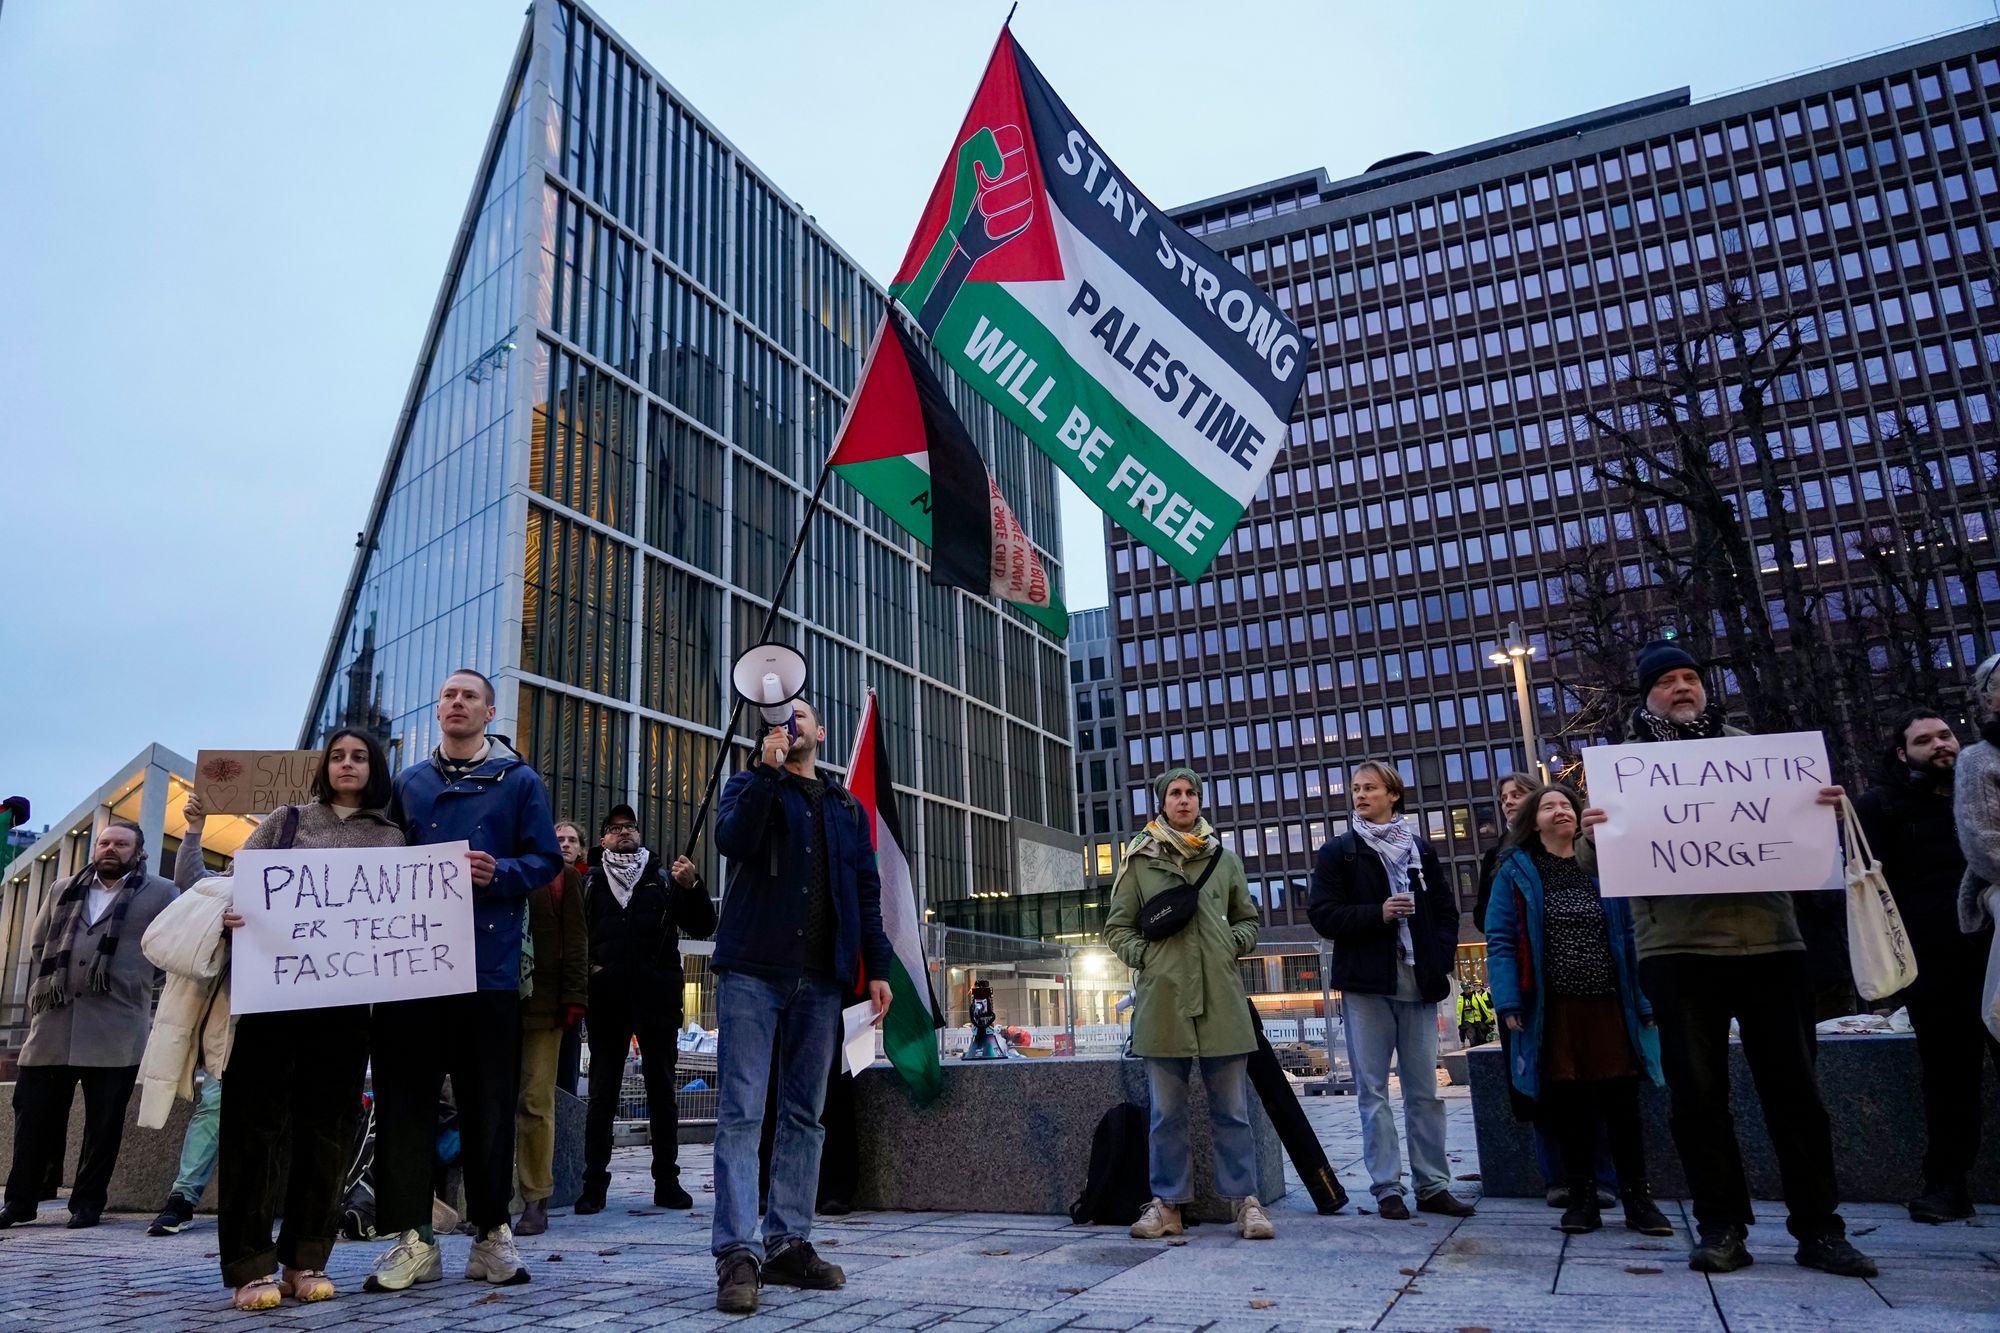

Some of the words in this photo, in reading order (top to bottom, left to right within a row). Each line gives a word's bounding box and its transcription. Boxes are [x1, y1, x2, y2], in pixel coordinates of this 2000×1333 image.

[1057, 129, 1148, 237] STAY
[1156, 230, 1300, 381] STRONG
[1067, 280, 1266, 471] PALESTINE
[963, 315, 1056, 423] WILL
[1056, 405, 1114, 474] BE
[1106, 454, 1215, 555] FREE
[1615, 756, 1823, 793] PALANTIR
[1663, 801, 1715, 824] UT
[1730, 797, 1771, 824] AV
[1650, 840, 1793, 873] NORGE
[263, 855, 463, 910] PALANTIR
[291, 920, 328, 940] ER
[344, 913, 443, 941] TECH-
[273, 944, 455, 985] FASCITER
